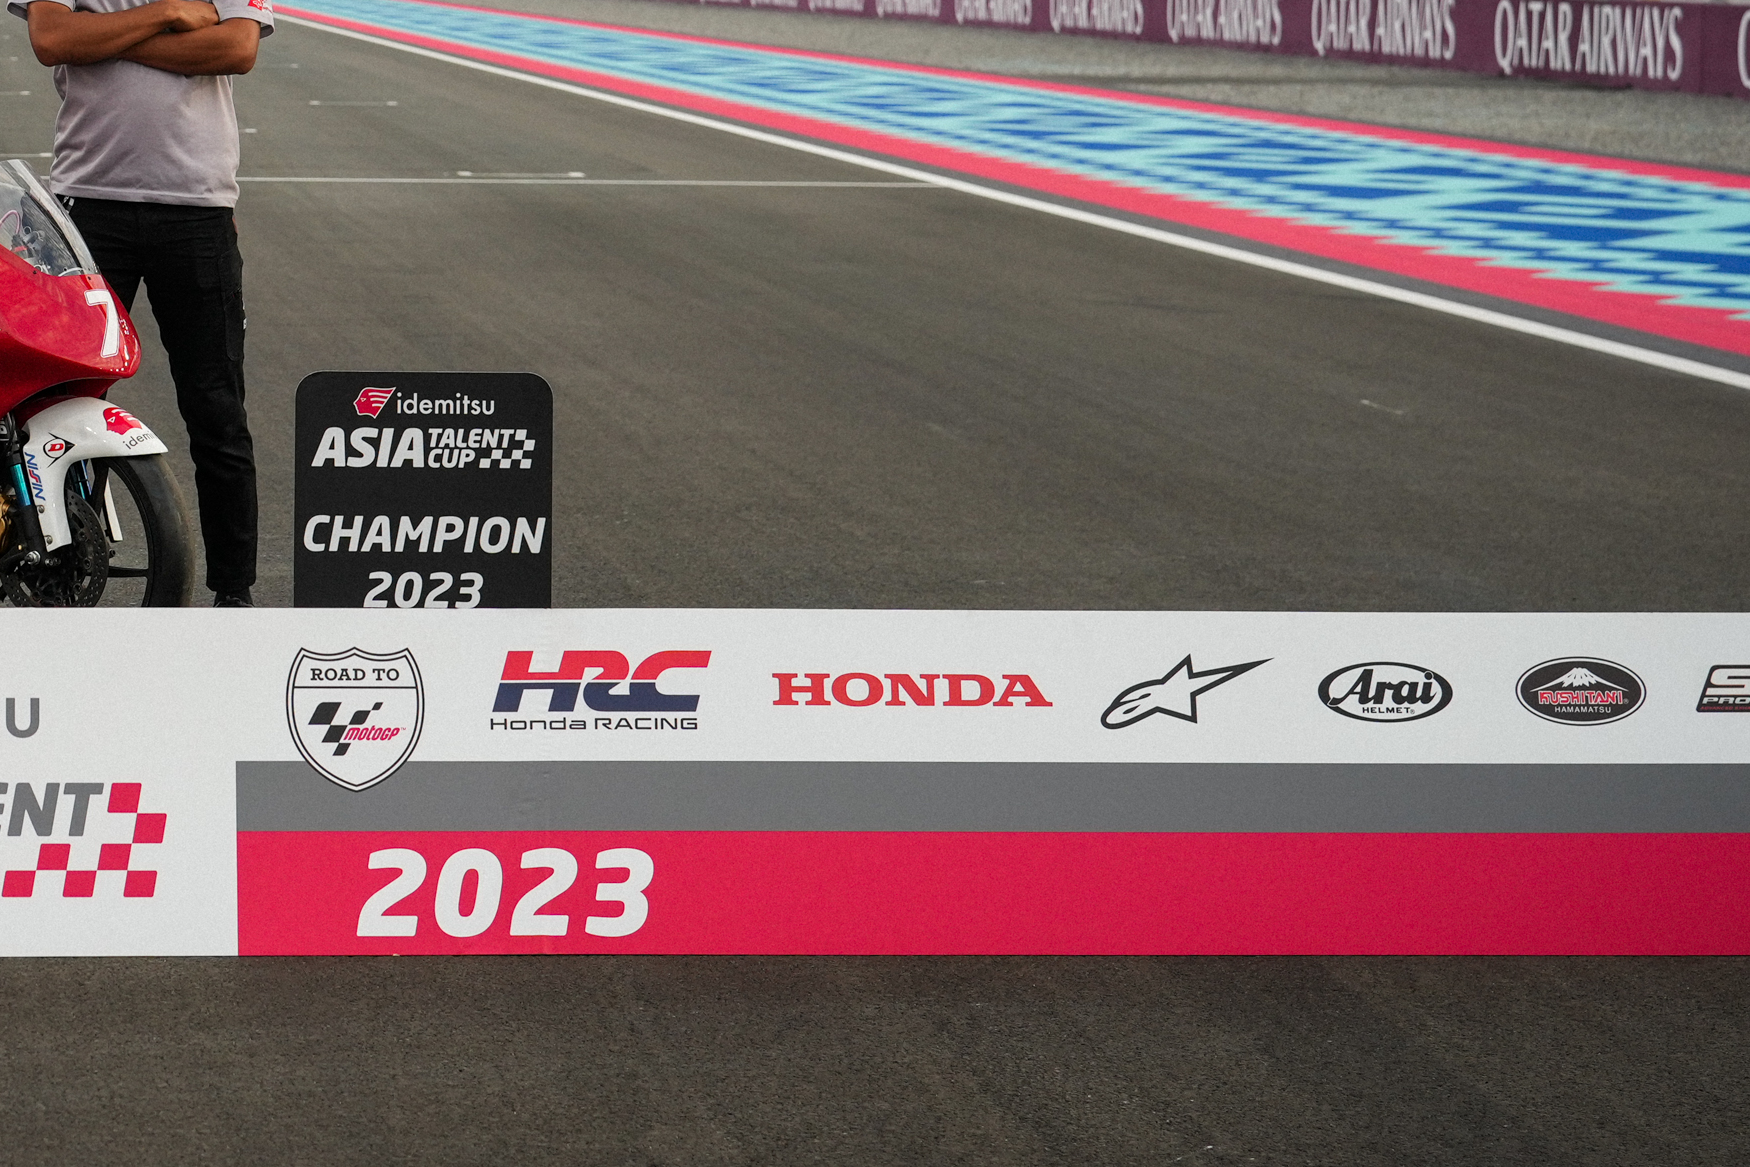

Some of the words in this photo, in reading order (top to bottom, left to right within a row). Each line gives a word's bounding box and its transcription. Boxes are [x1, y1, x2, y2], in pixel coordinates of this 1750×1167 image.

[1575, 3, 1683, 82] AIRWAYS
[84, 289, 120, 358] 7
[397, 393, 495, 415] idemitsu
[311, 426, 425, 468] ASIA
[428, 428, 514, 449] TALENT
[427, 449, 476, 468] CUP
[303, 514, 546, 554] CHAMPION
[363, 571, 484, 608] 2023
[310, 668, 366, 681] ROAD
[372, 668, 400, 681] TO
[492, 650, 712, 712] HRC
[772, 672, 1053, 707] HONDA
[1327, 668, 1438, 707] Arai
[1538, 690, 1623, 705] KUSHITANI
[1554, 706, 1611, 714] HAMAMATSU
[490, 717, 587, 730] Honda
[594, 717, 698, 730] RACING
[356, 847, 655, 938] 2023
